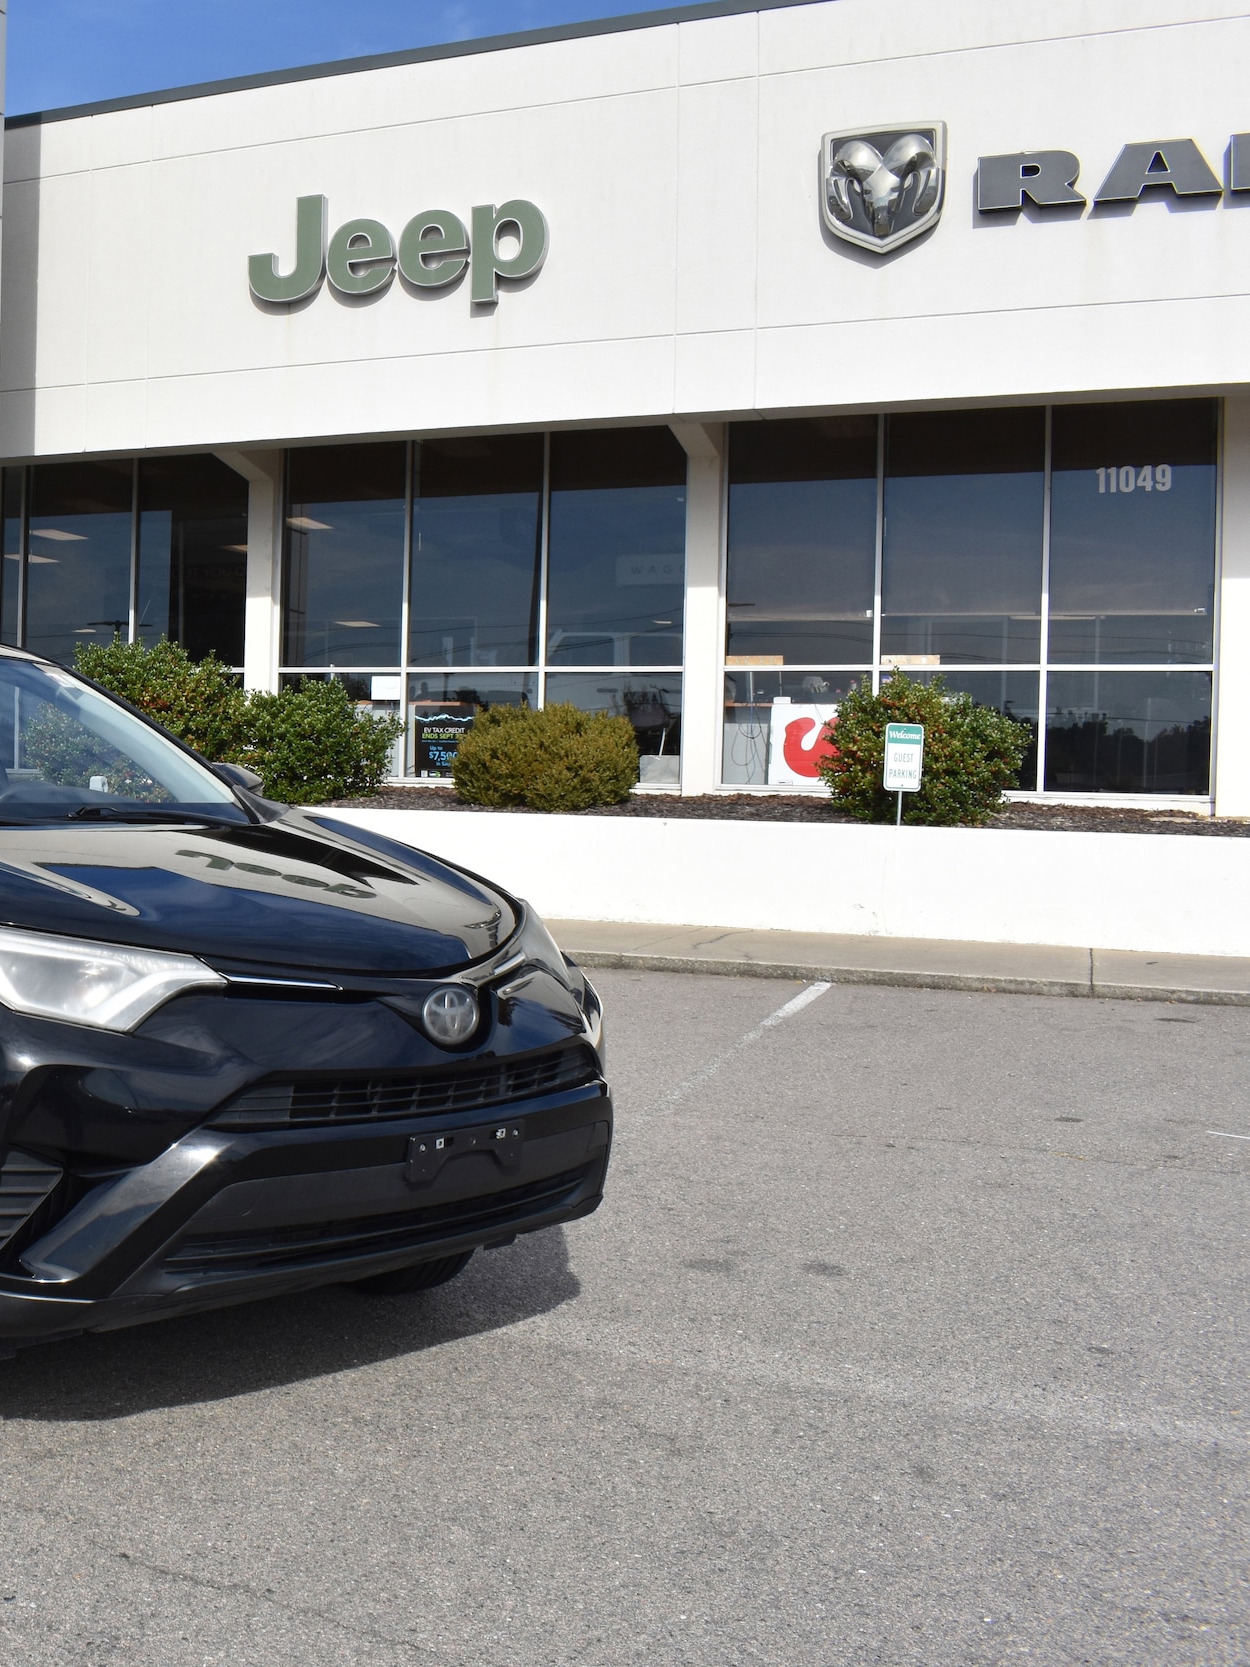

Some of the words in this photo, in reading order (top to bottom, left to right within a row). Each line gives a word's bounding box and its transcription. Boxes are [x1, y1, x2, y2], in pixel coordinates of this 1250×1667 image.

[977, 133, 1250, 212] RA
[248, 194, 549, 305] Jeep
[1096, 464, 1172, 493] 11049
[889, 730, 921, 740] Welcome
[894, 752, 914, 763] GUEST
[889, 769, 917, 779] PARKING
